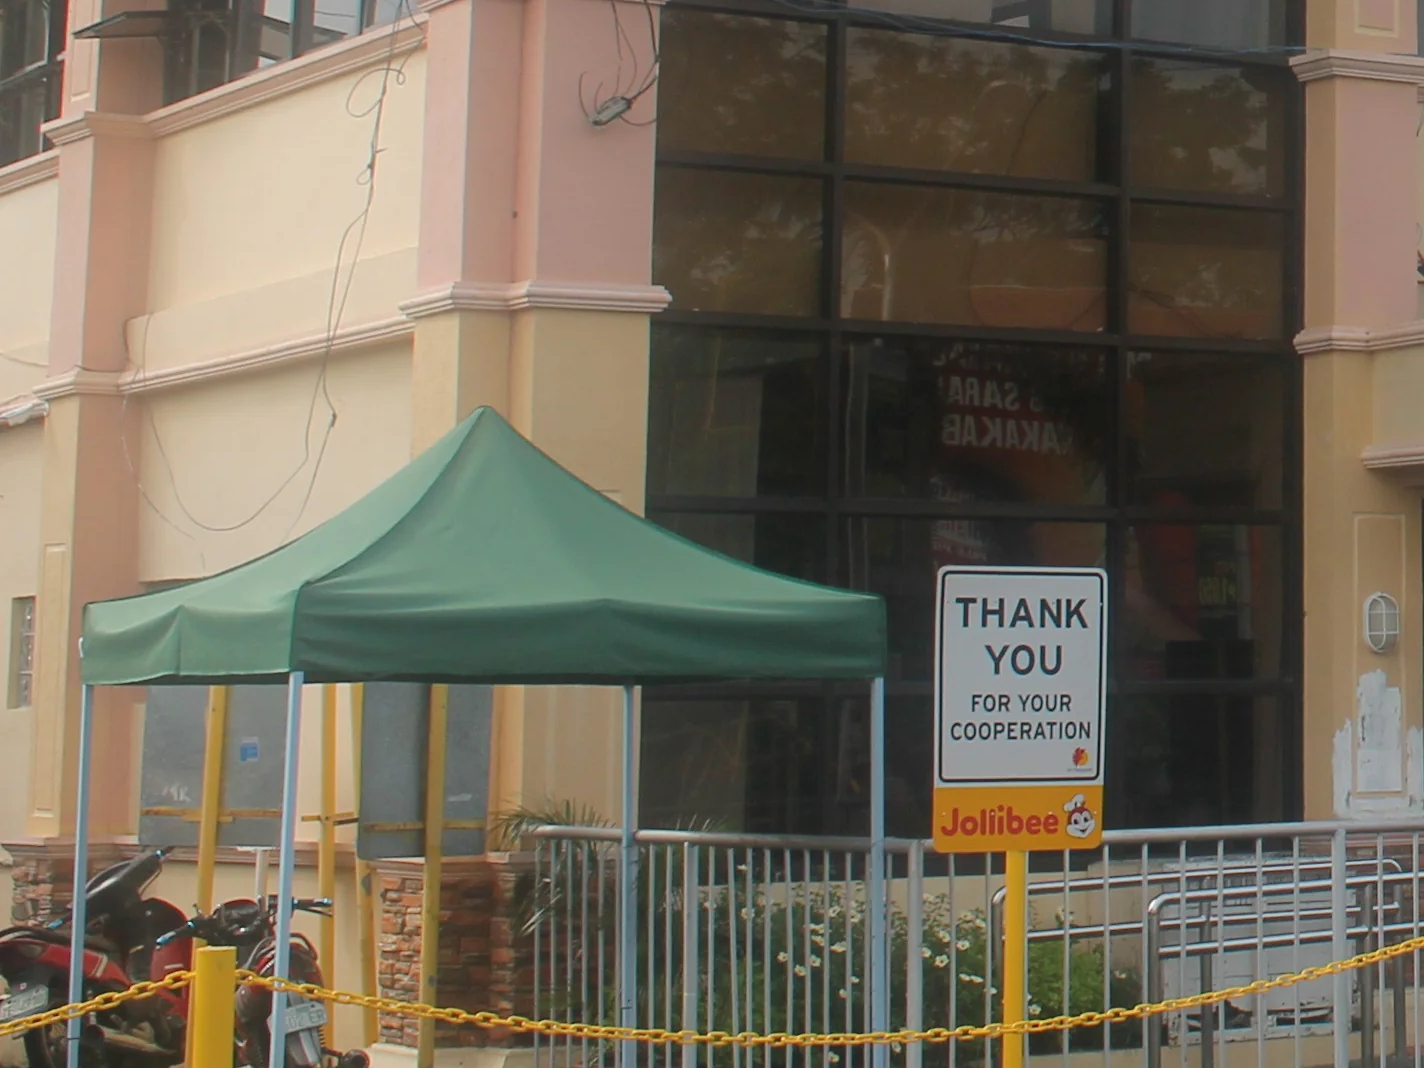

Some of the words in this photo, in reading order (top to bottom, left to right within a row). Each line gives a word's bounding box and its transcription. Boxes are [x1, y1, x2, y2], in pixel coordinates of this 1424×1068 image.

[955, 597, 1089, 629] THANK
[984, 643, 1063, 676] YOU
[971, 694, 1011, 712] FOR
[1018, 694, 1072, 712] YOUR
[950, 721, 1092, 740] COOPERATION
[941, 805, 1059, 837] Jollibee
